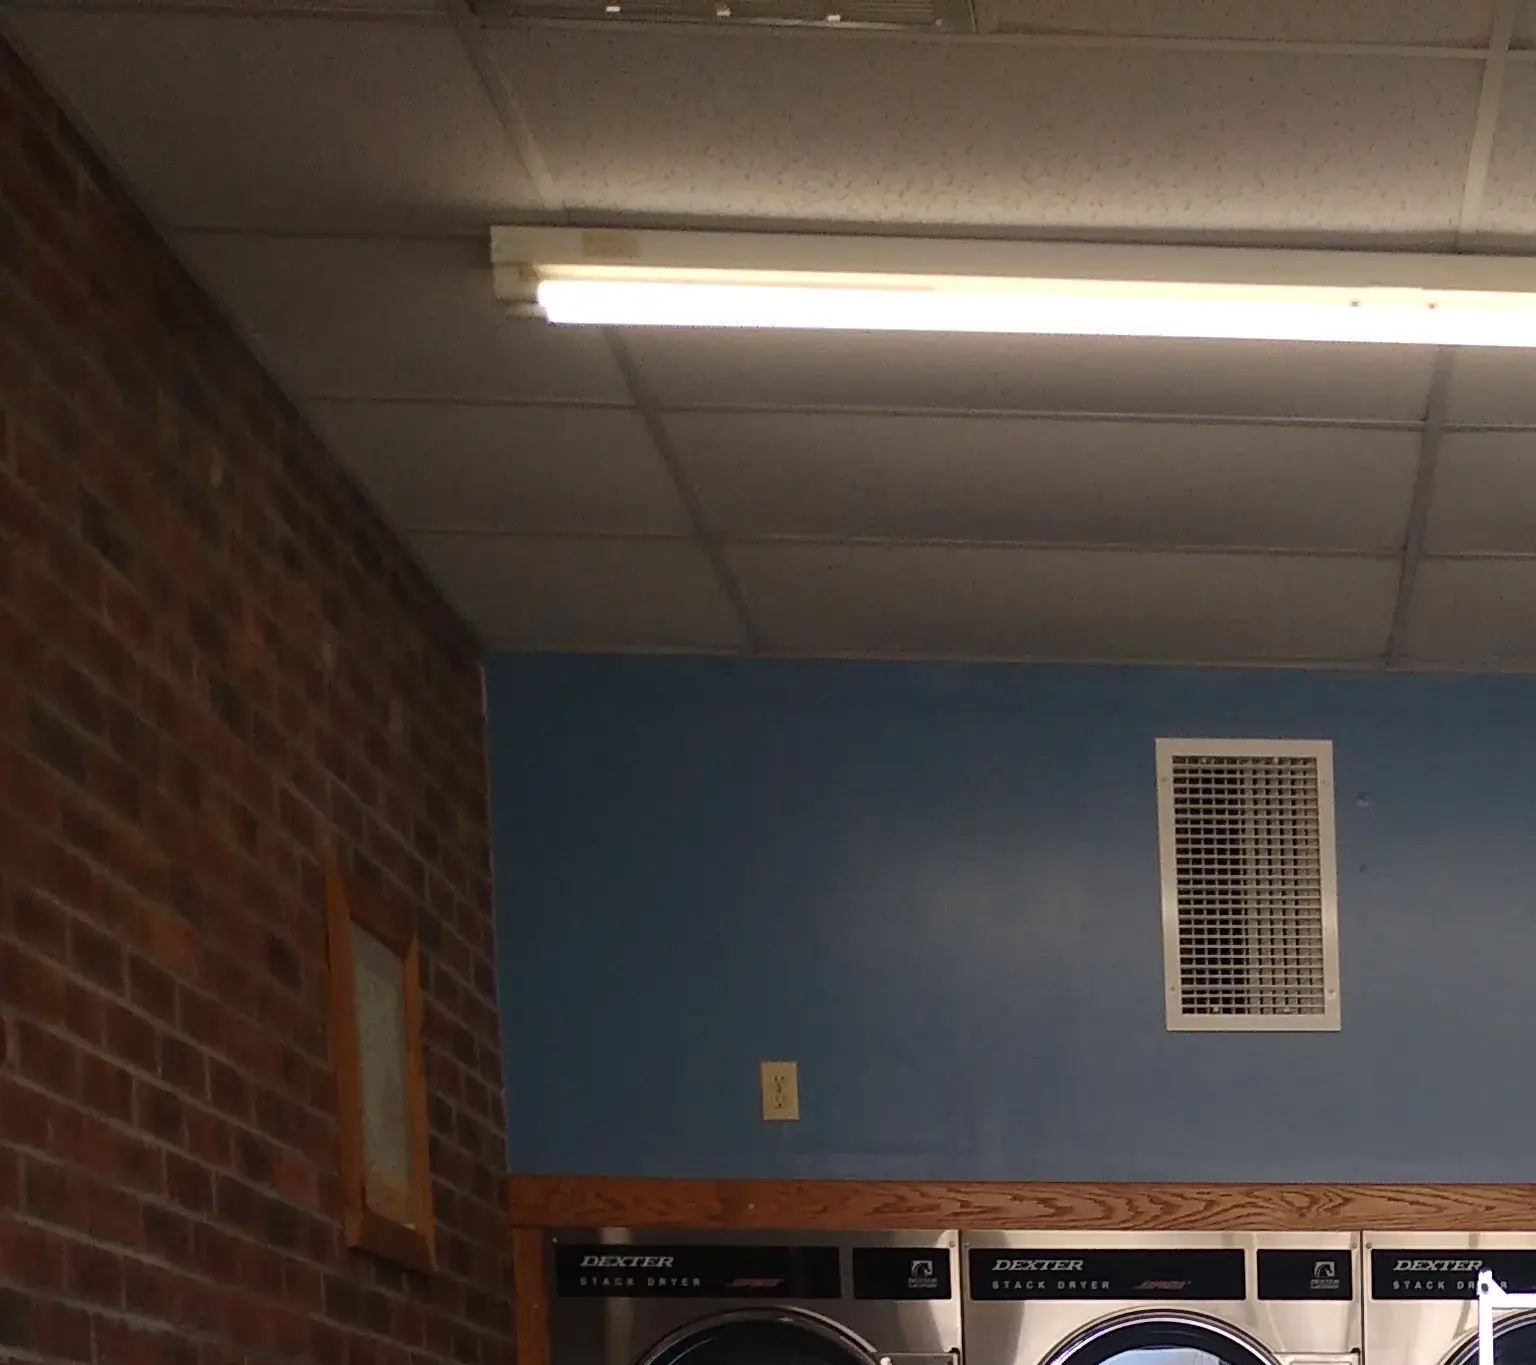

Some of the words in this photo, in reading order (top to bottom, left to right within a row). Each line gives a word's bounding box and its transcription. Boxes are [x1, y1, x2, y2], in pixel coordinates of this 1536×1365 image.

[580, 1255, 675, 1268] DEXTER
[992, 1259, 1084, 1271] DEXTER
[1393, 1259, 1483, 1271] DEXTER
[579, 1276, 636, 1287] STACK
[647, 1277, 701, 1287] DRYER
[992, 1280, 1046, 1290] STACK
[1057, 1280, 1110, 1290] DRYER
[1392, 1280, 1445, 1290] STACK
[1456, 1280, 1508, 1290] DRR
